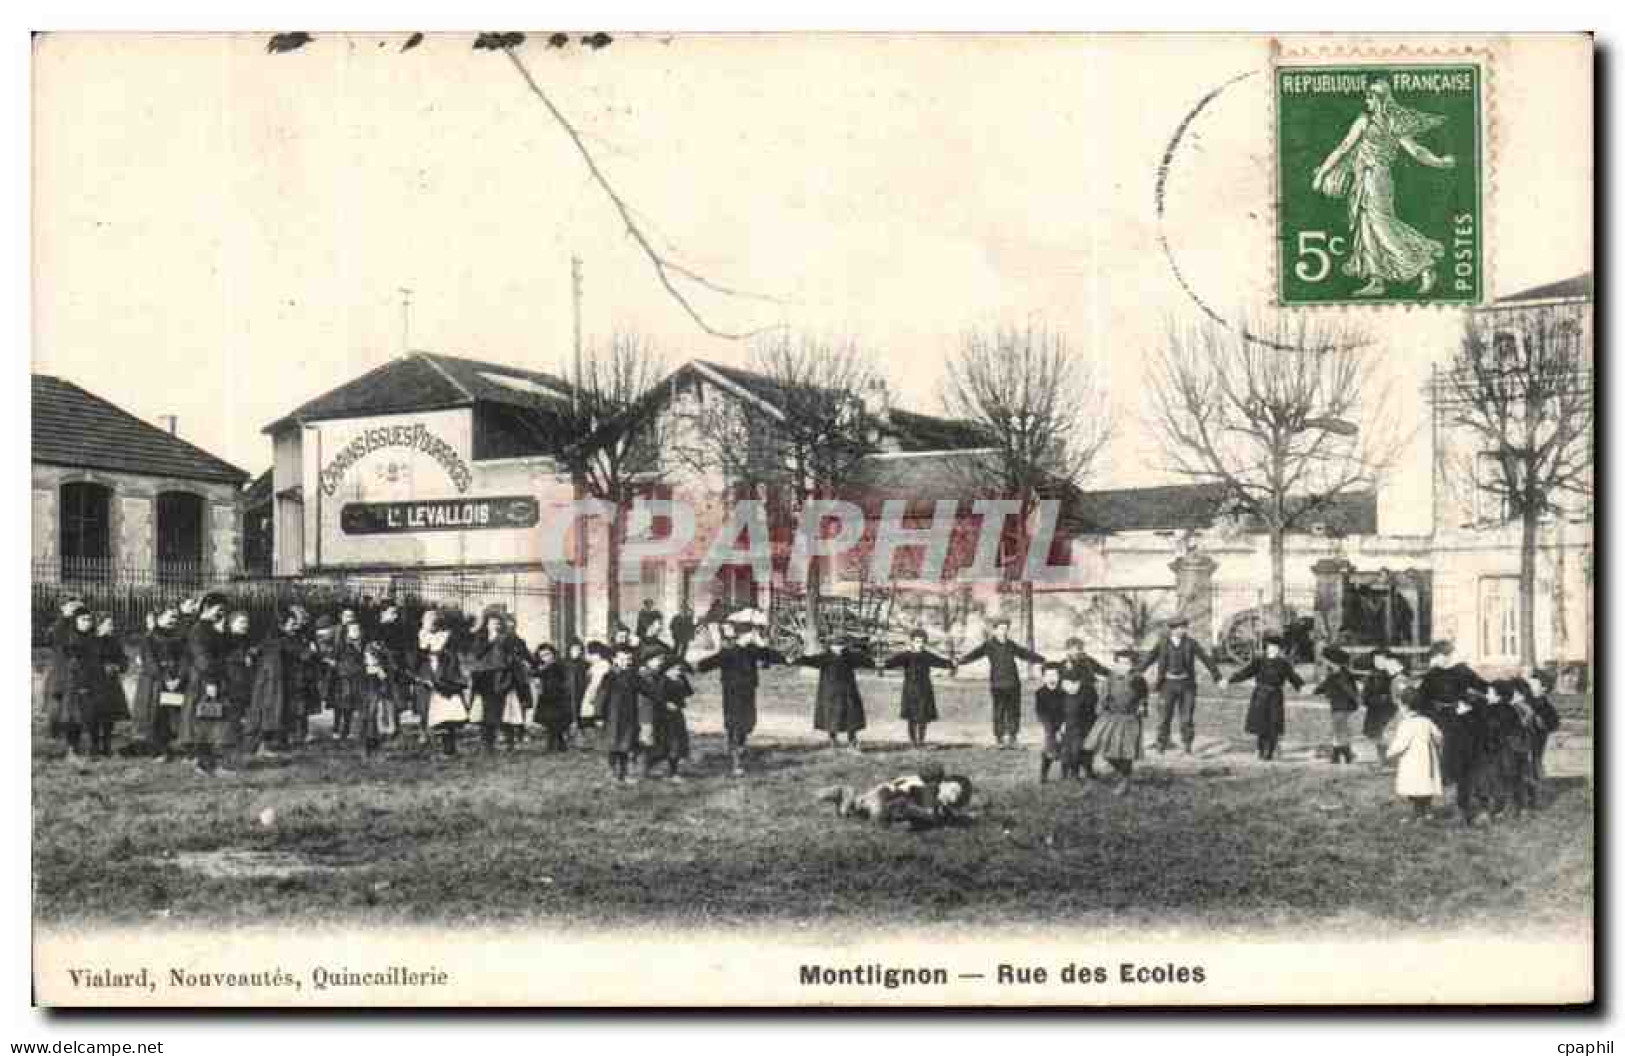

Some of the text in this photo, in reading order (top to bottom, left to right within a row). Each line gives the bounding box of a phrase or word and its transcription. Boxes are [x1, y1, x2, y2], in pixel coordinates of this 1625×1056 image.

[1282, 72, 1473, 95] REPUBLIQUE FRANÇAISE
[1453, 212, 1474, 292] POSTES
[407, 503, 489, 527] LEVALLOIS
[68, 966, 449, 991] Vialard, Nouveautés, Quincaillerie
[799, 964, 947, 988] Montlignon
[997, 965, 1048, 984] Rue
[1060, 963, 1107, 985] des
[1119, 963, 1206, 984] Ecoles
